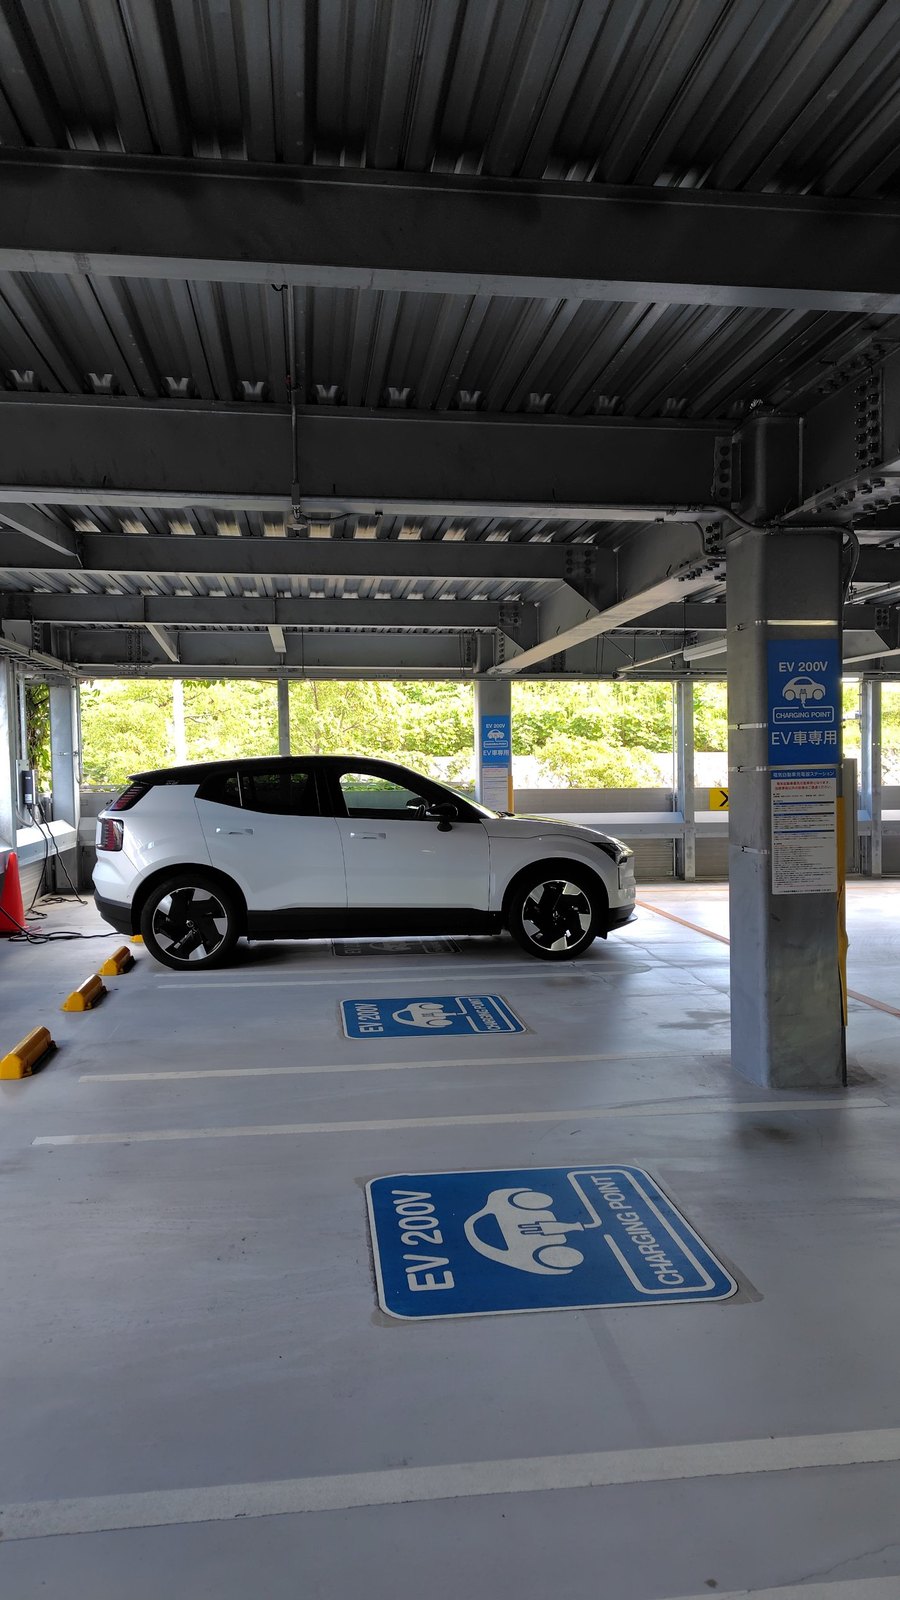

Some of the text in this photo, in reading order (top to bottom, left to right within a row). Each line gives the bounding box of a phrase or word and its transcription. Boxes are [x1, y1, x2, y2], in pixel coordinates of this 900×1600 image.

[778, 661, 828, 672] EV 200V
[775, 711, 810, 719] CHARGING
[771, 730, 837, 746] EV車専用
[354, 1003, 384, 1033] EV 200V
[391, 1190, 455, 1292] EV 200V
[589, 1175, 685, 1286] CHARGING POINT
